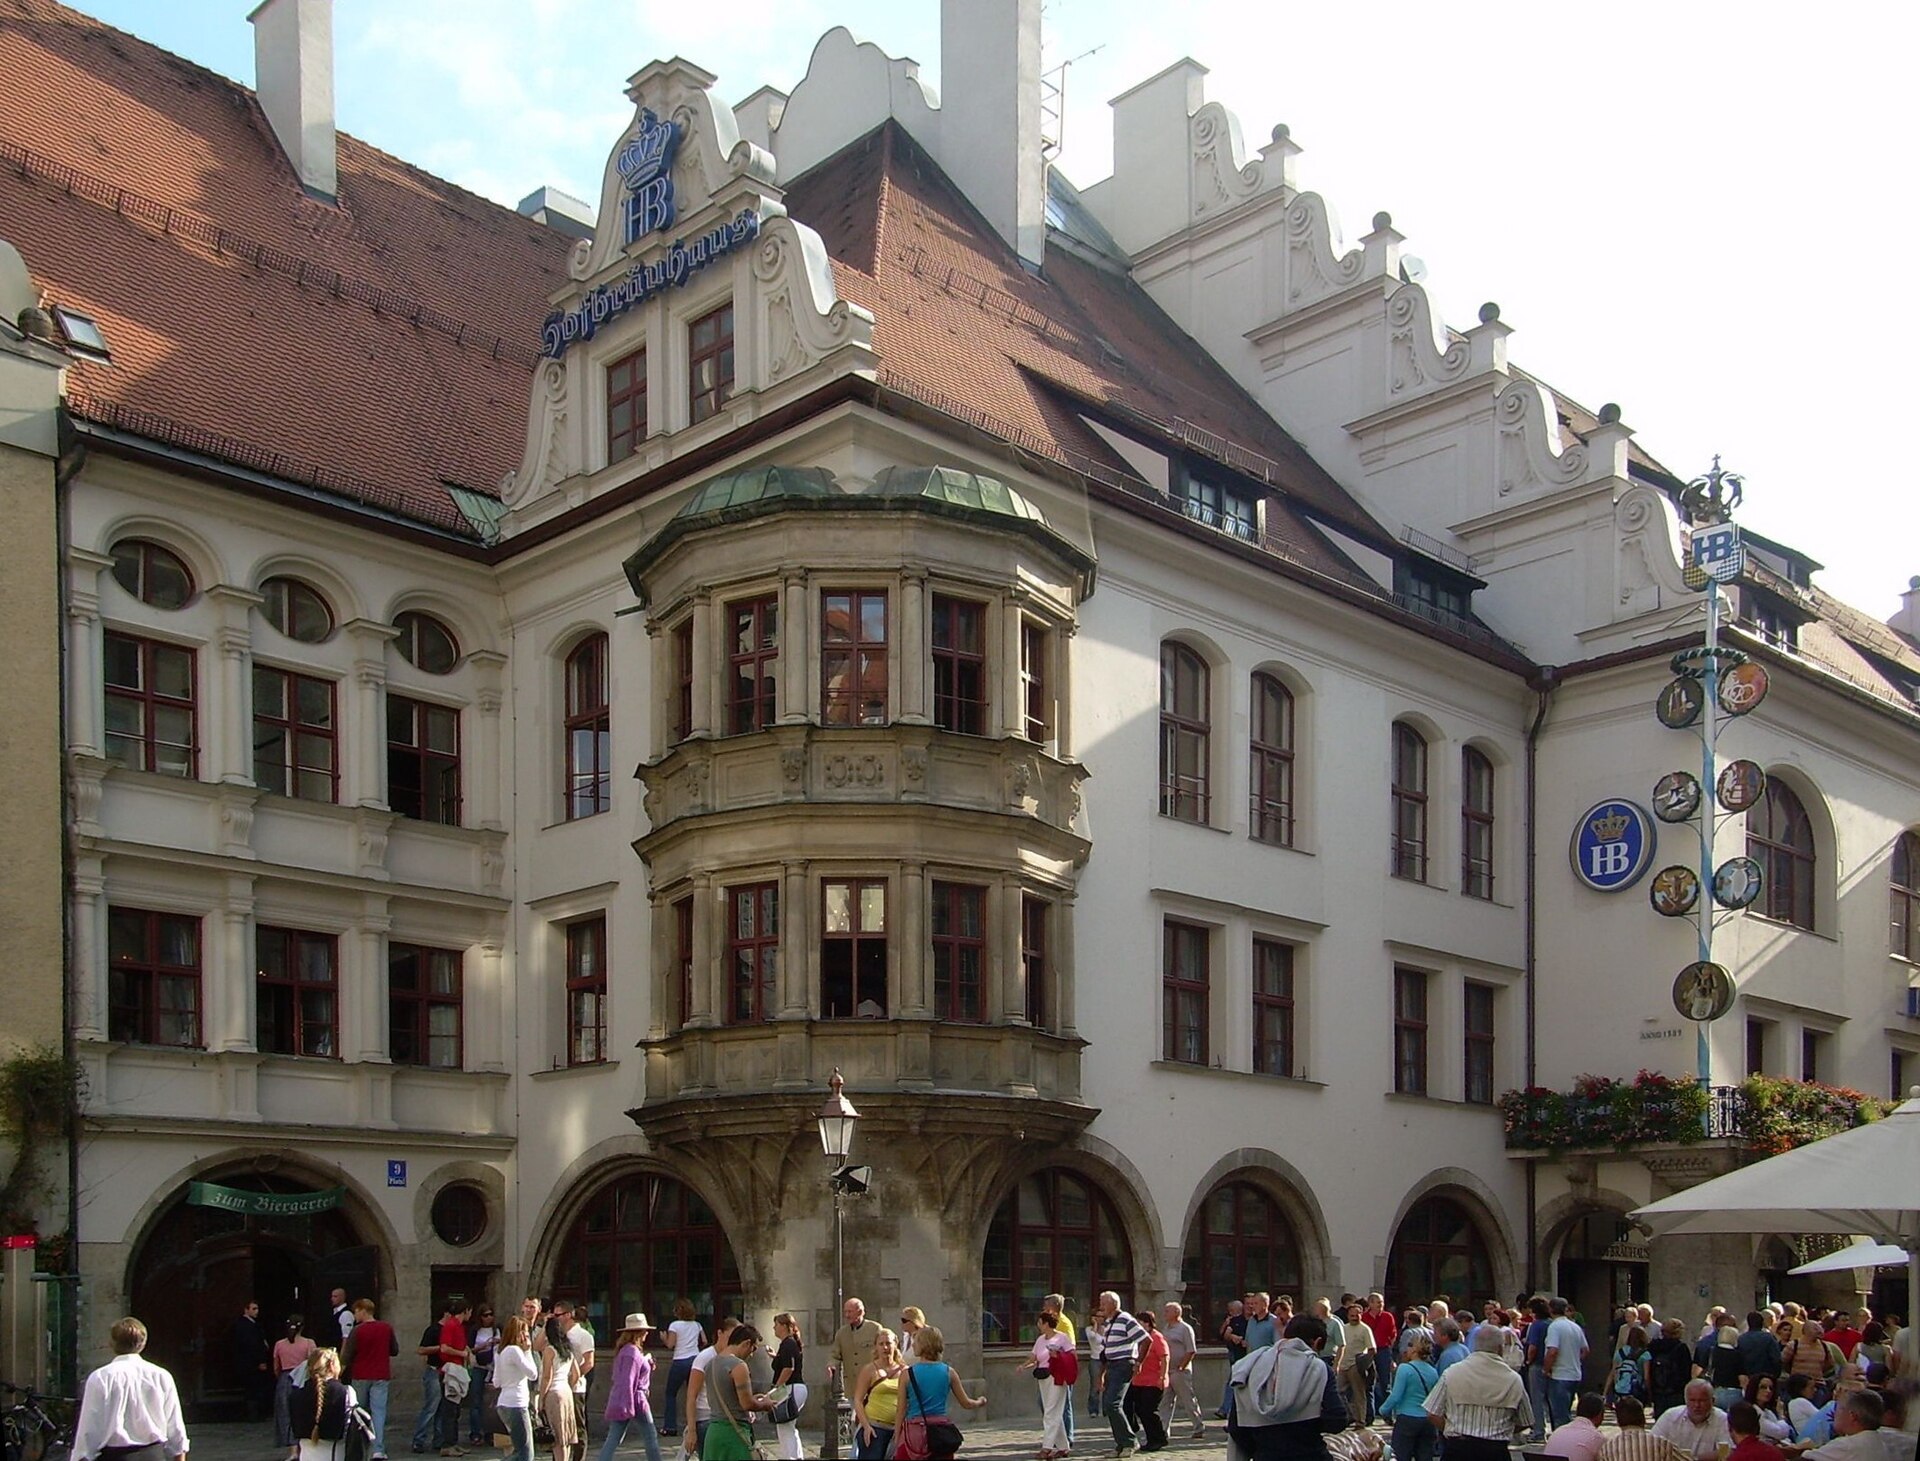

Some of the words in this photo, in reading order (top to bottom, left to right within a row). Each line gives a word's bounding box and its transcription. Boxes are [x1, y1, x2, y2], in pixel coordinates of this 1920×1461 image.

[622, 175, 676, 243] HB
[541, 208, 760, 359] Hofbräuhaus
[1692, 530, 1733, 567] HB
[1590, 842, 1630, 877] HB
[393, 1163, 401, 1176] 9
[254, 1195, 337, 1215] Biergarten
